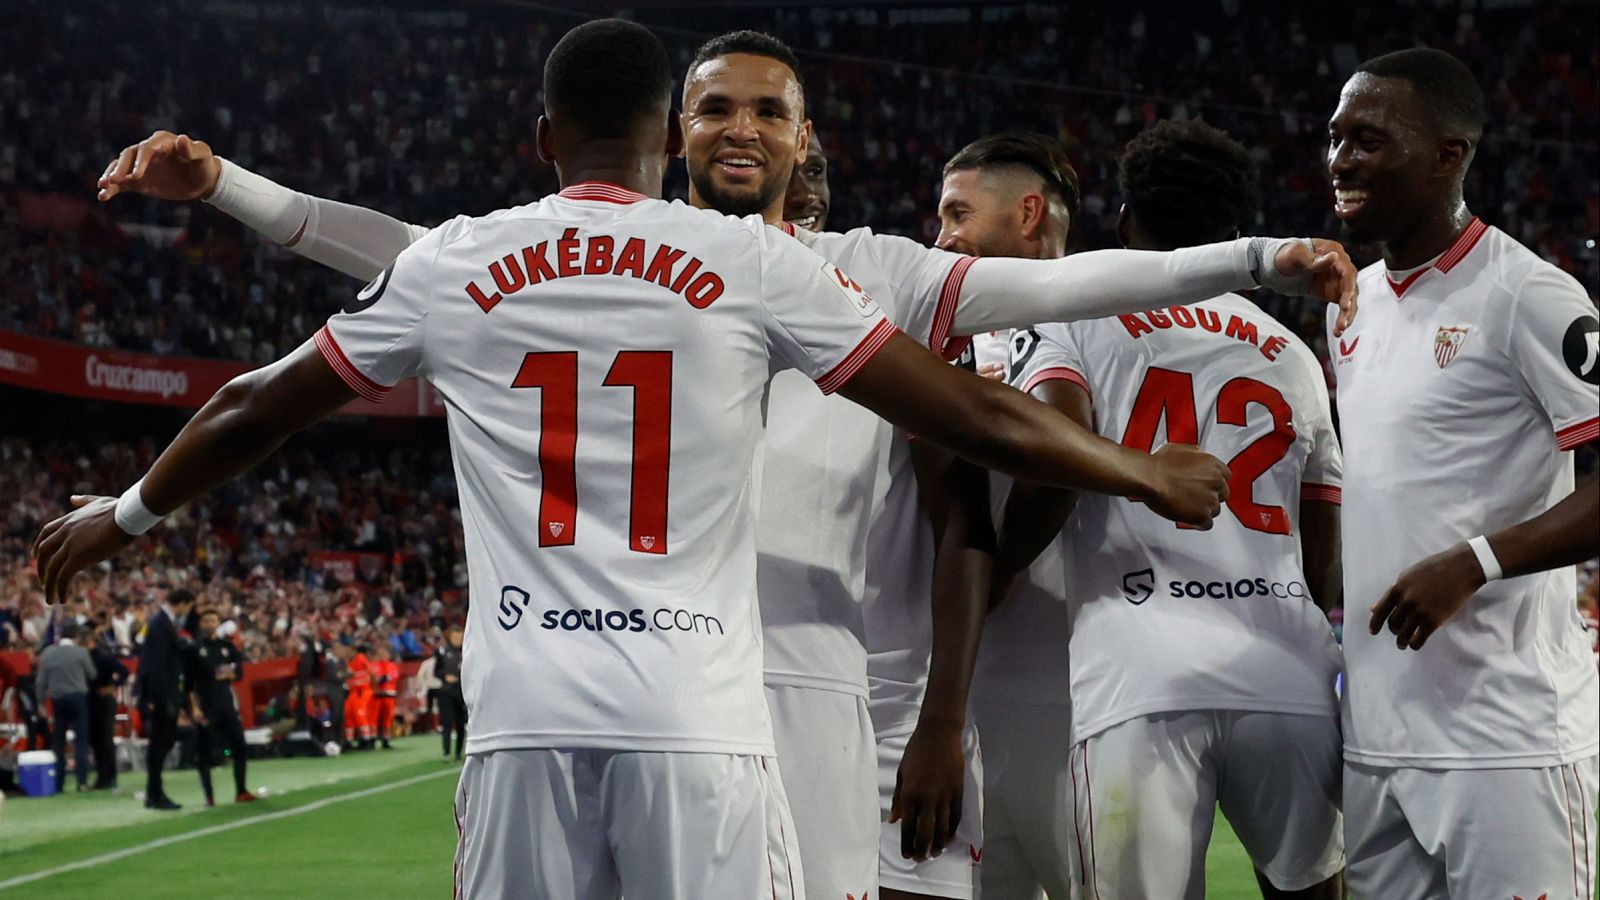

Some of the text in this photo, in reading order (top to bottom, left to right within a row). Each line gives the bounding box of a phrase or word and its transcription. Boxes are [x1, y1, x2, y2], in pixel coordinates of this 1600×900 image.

[465, 228, 725, 314] LUKÉBAKIO
[85, 354, 188, 399] Cruzcampo
[510, 351, 673, 555] 11
